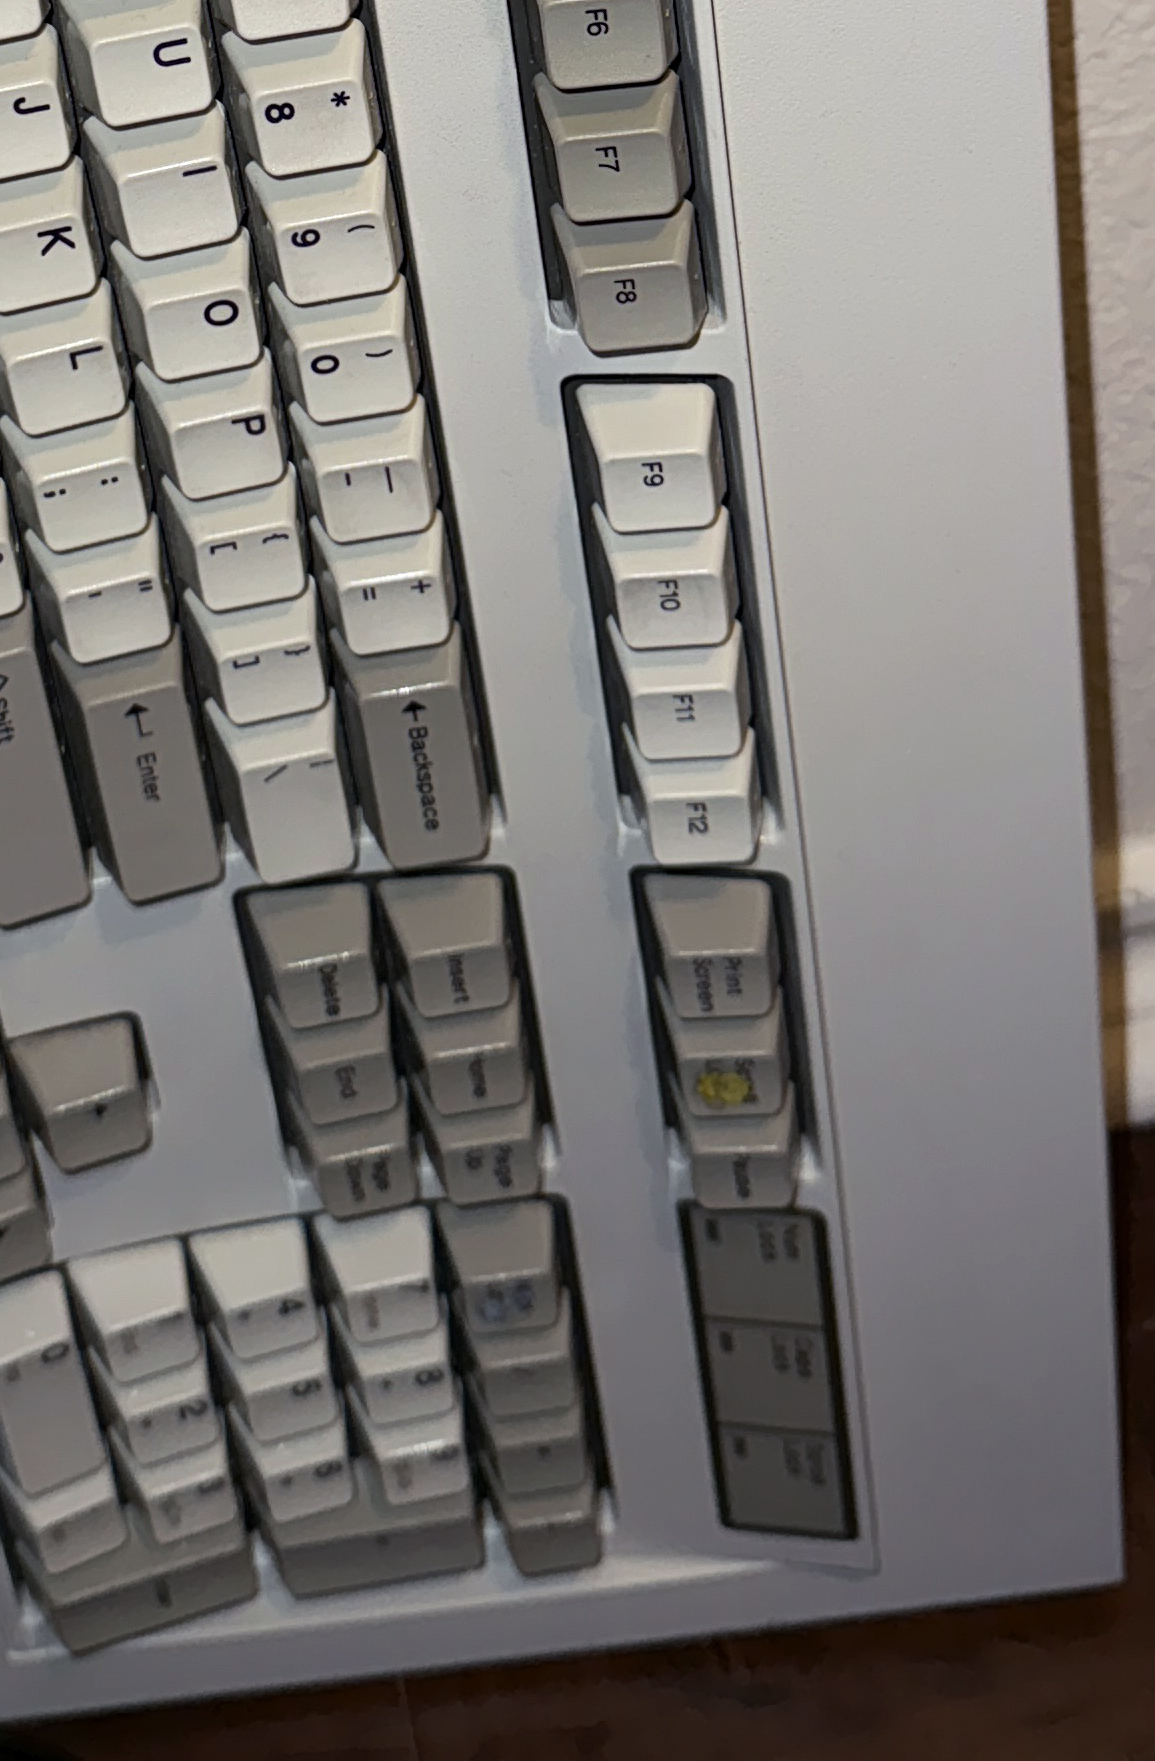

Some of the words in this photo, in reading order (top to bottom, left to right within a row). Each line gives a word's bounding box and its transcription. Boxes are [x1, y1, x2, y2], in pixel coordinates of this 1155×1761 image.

[584, 8, 609, 37] F6
[153, 37, 192, 67] U
[13, 97, 51, 115] J
[264, 102, 295, 124] 8
[595, 145, 620, 173] F7
[37, 225, 76, 257] K
[291, 228, 321, 248] 9
[614, 278, 637, 305] F8
[203, 299, 239, 327] O
[69, 345, 104, 370] L
[231, 414, 266, 436] P
[641, 461, 664, 487] F9
[657, 579, 681, 612] F10
[672, 694, 695, 723] F11
[136, 751, 160, 802] Enter
[408, 726, 439, 831] Backspace
[686, 802, 707, 835] F12
[694, 957, 714, 1012] Screen
[724, 957, 742, 998] Print
